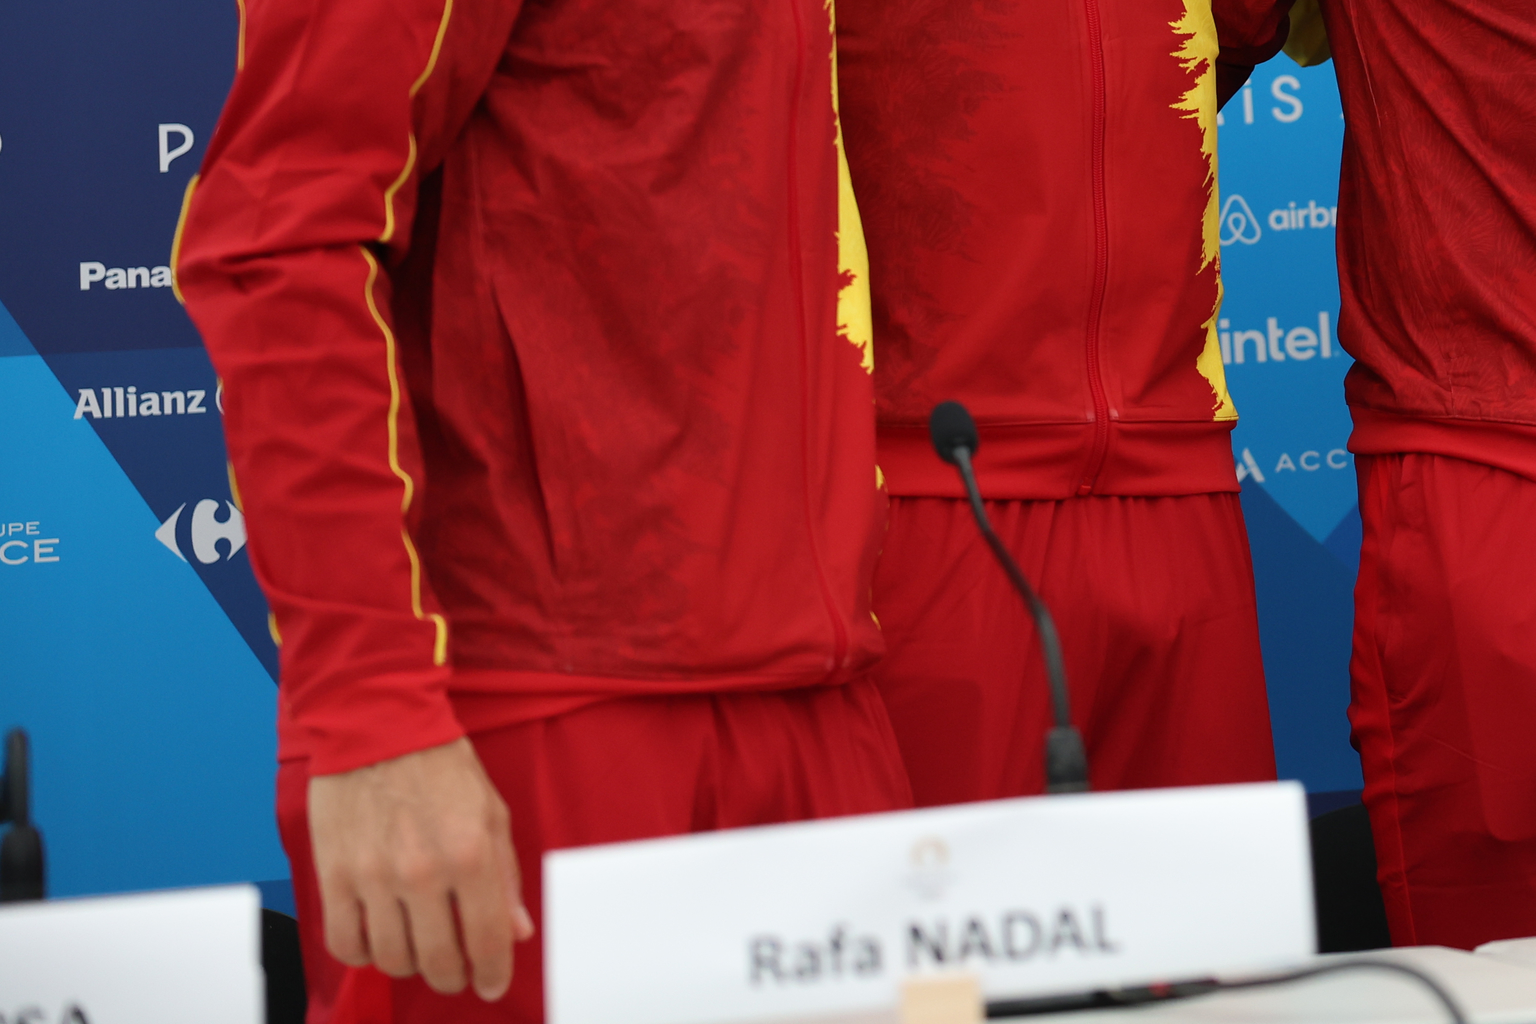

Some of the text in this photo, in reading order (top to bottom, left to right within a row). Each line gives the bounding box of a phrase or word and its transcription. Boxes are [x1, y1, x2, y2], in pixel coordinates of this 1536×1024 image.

[79, 261, 173, 290] Pana
[1219, 311, 1332, 365] intel
[73, 386, 207, 420] Allianz
[750, 902, 1121, 985] Rafa NADAL
